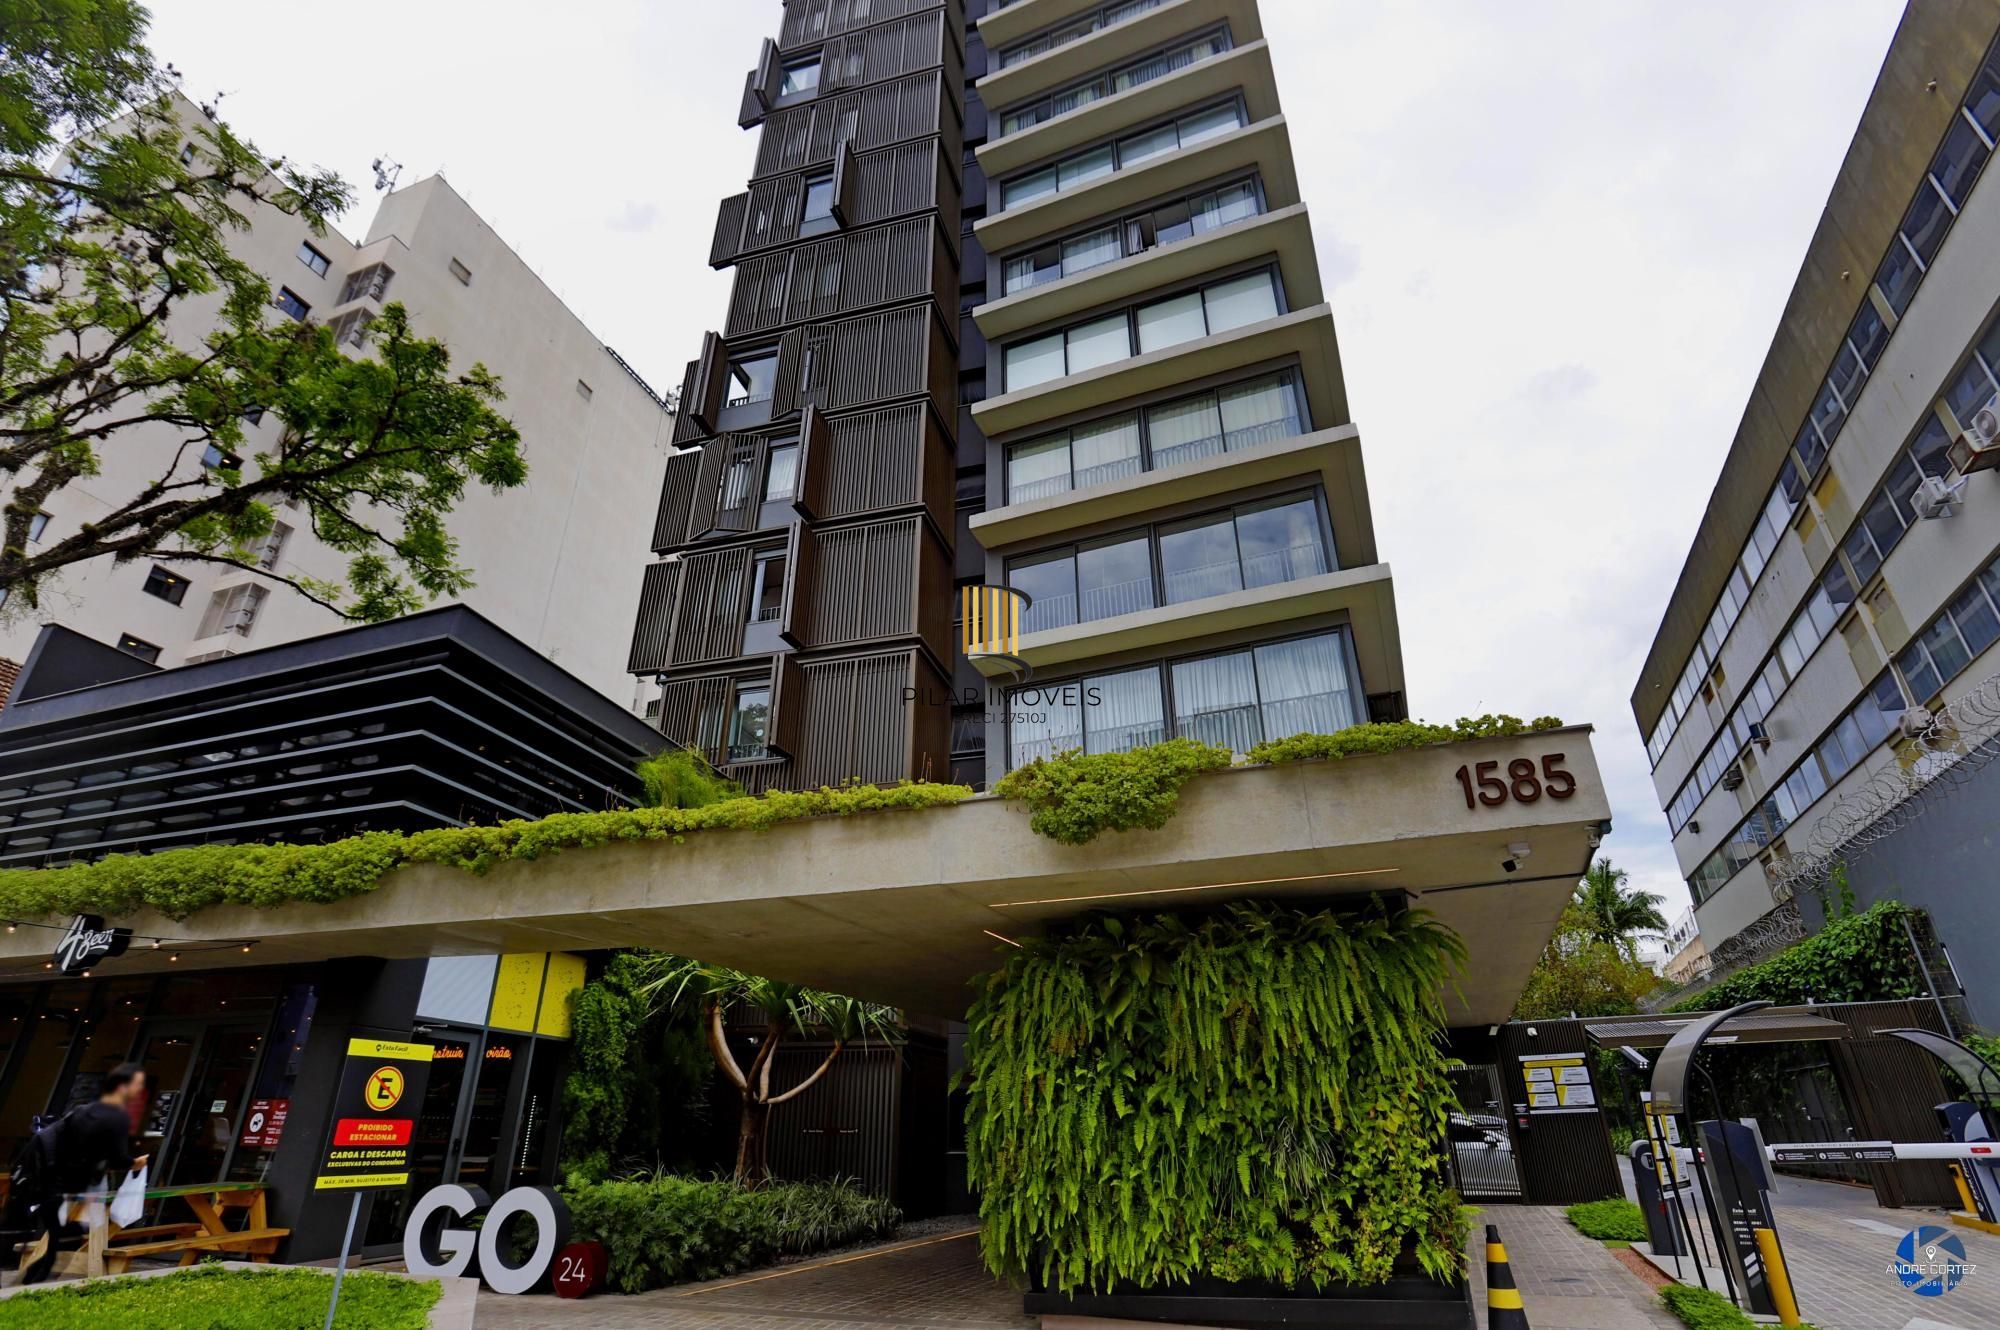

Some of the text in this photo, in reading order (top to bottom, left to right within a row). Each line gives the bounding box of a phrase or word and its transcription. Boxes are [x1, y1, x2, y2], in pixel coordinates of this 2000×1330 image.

[1455, 752, 1577, 810] 1585
[377, 1078, 393, 1099] E
[349, 1133, 397, 1141] ESTACIONAR
[358, 1123, 394, 1131] PROIBIDO
[330, 1151, 359, 1159] CARGA
[366, 1150, 407, 1158] DESCARGA
[404, 1184, 557, 1295] GO
[559, 1256, 586, 1283] 24
